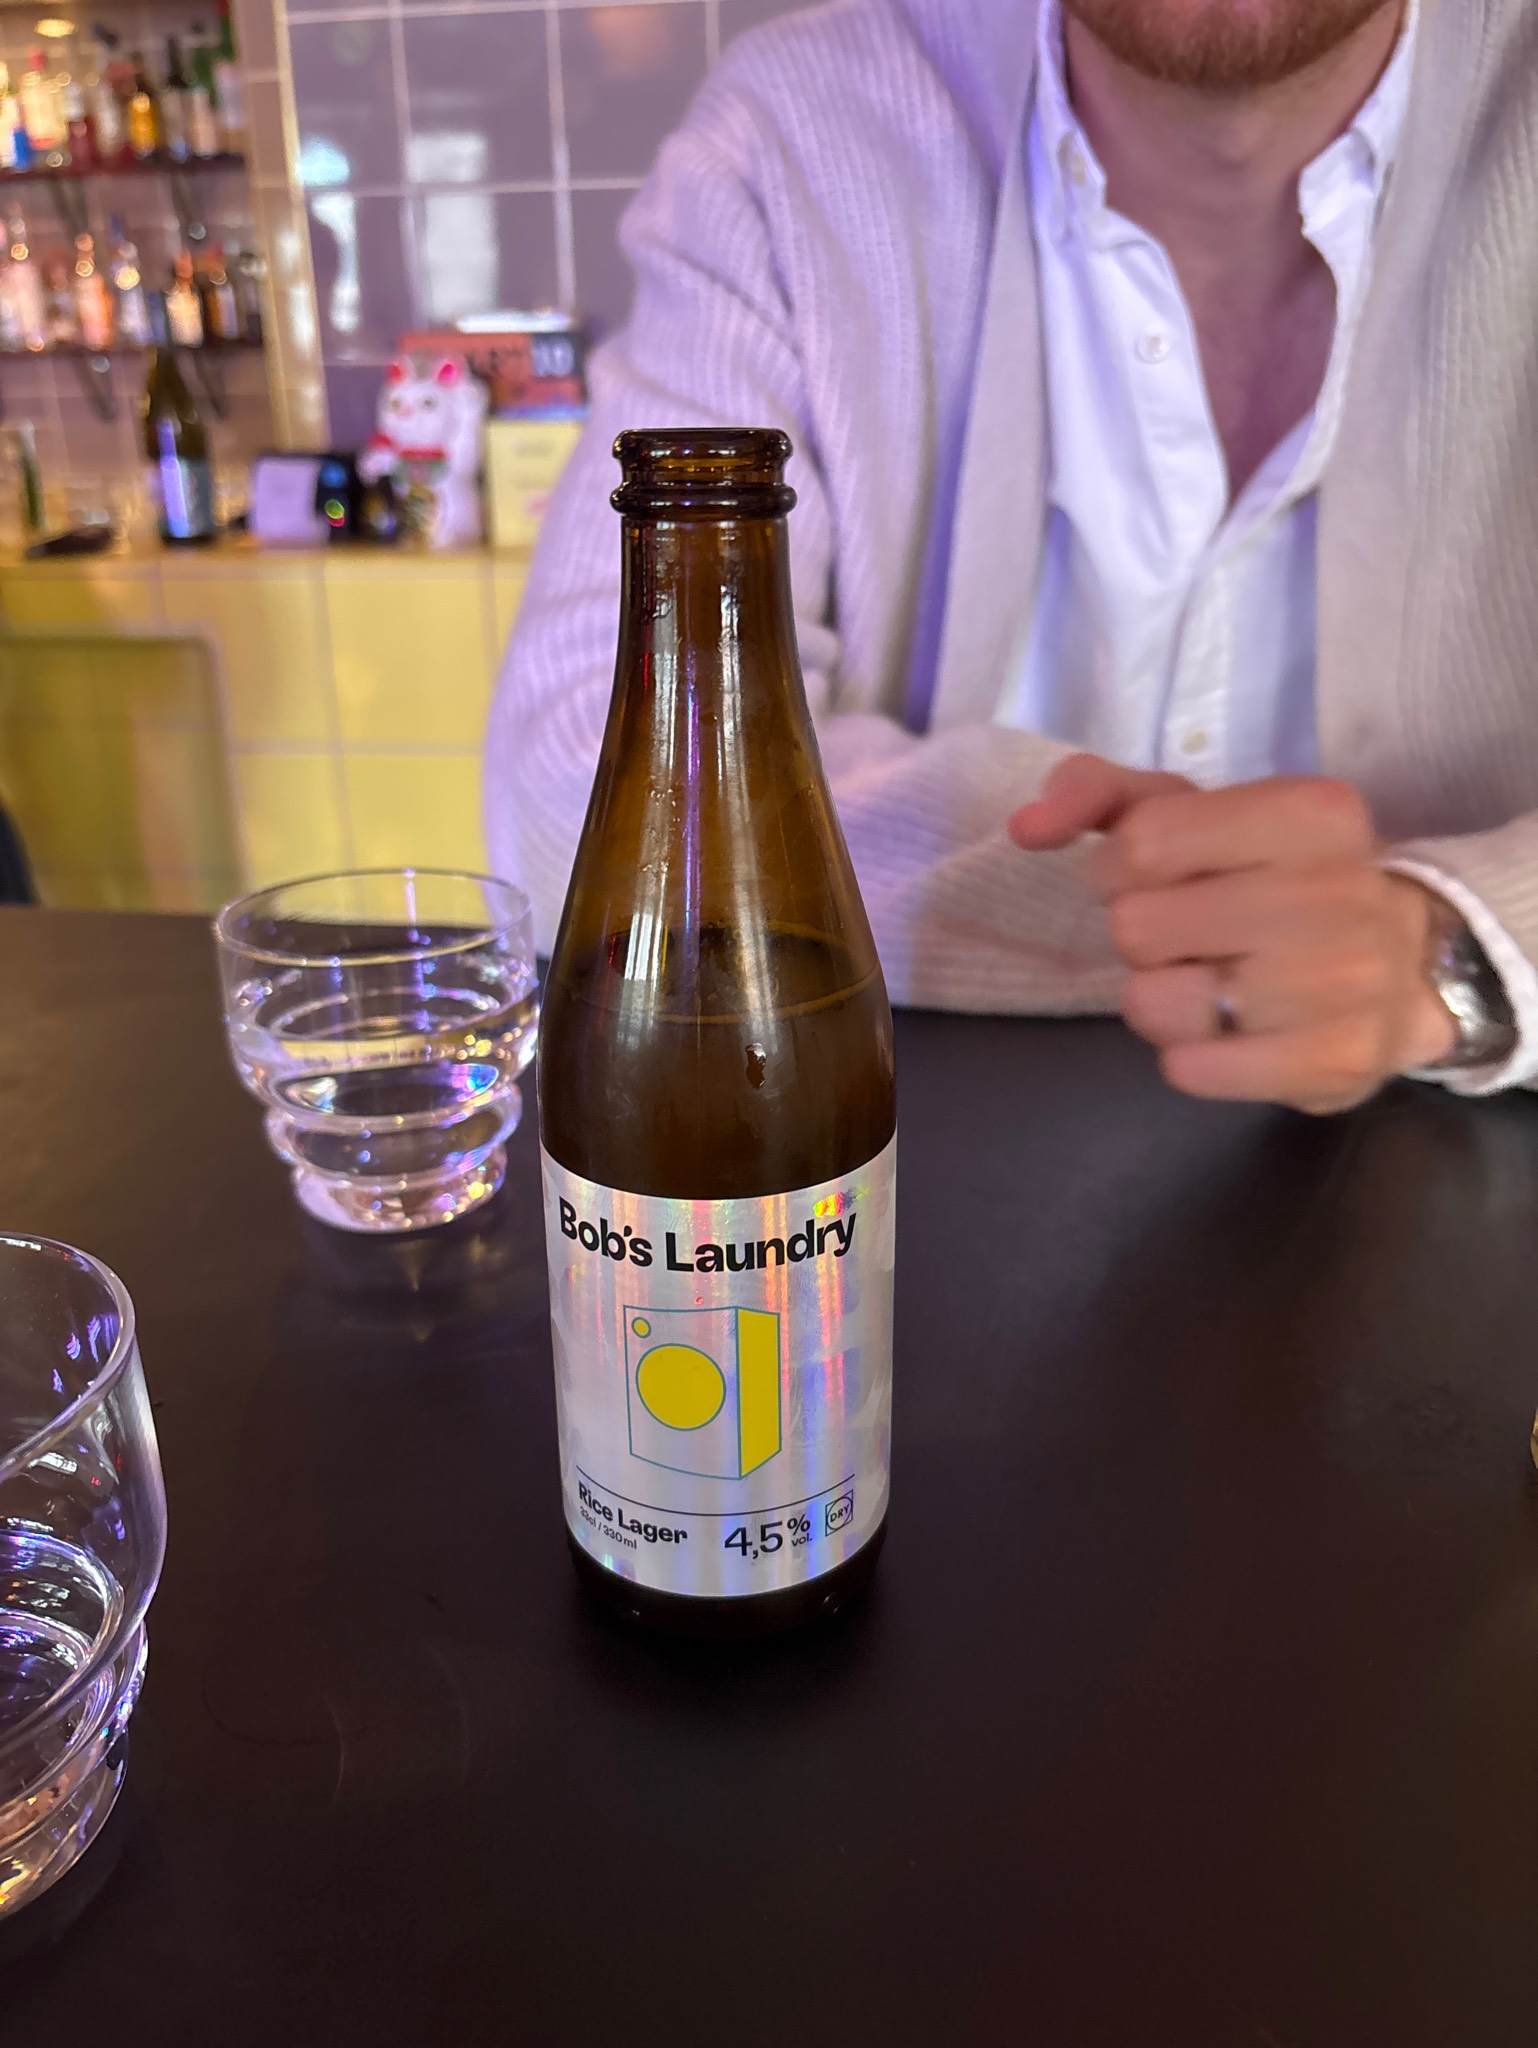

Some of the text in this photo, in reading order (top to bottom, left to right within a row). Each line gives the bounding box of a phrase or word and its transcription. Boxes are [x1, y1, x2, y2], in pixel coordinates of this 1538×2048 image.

[559, 1196, 857, 1273] Bob's Laundry
[578, 1480, 688, 1544] Rice Lager
[579, 1505, 597, 1527] 33cl
[829, 1503, 851, 1523] DRY
[791, 1532, 813, 1547] vol.
